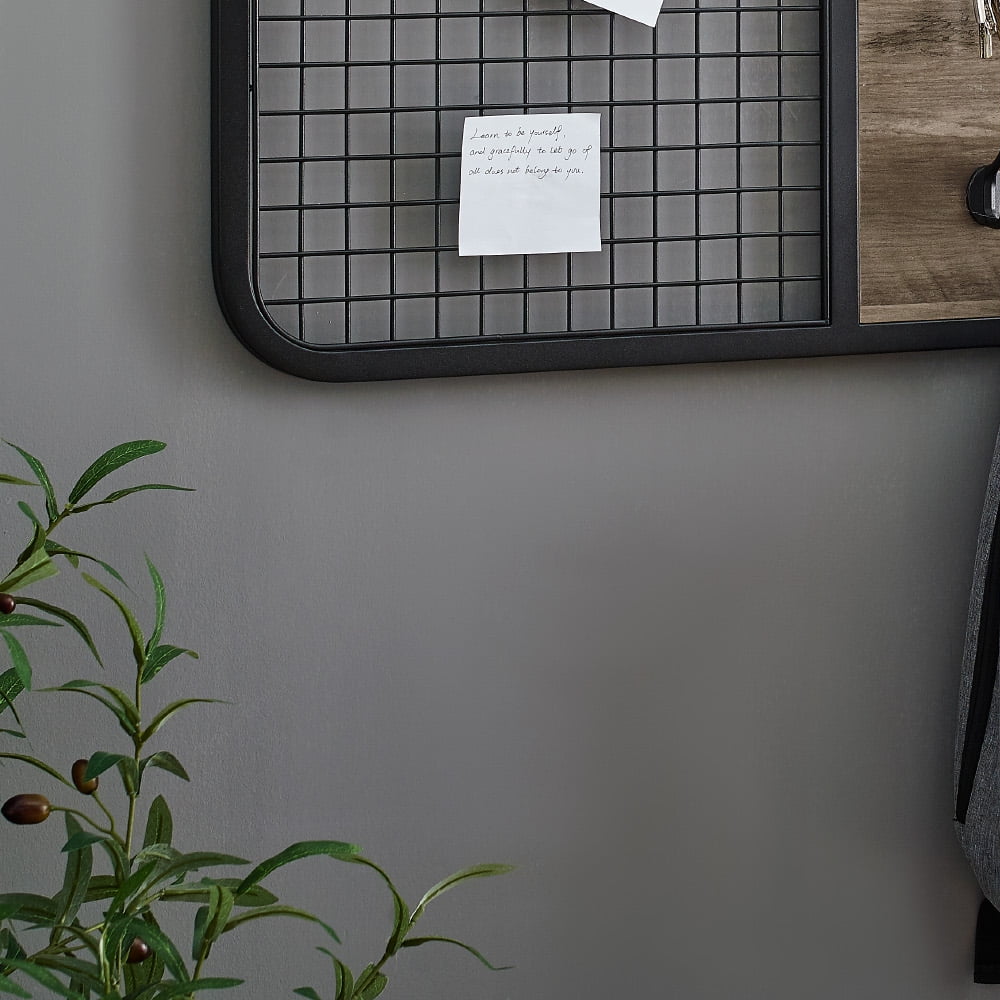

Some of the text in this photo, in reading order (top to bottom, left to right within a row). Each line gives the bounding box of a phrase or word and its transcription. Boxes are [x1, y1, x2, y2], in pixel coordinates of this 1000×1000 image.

[470, 128, 500, 140] Learn
[516, 127, 525, 136] be
[469, 147, 486, 155] and
[488, 145, 531, 160] gracefully
[564, 148, 576, 160] go
[583, 145, 592, 160] of
[485, 167, 504, 175] does
[525, 165, 549, 179] belong
